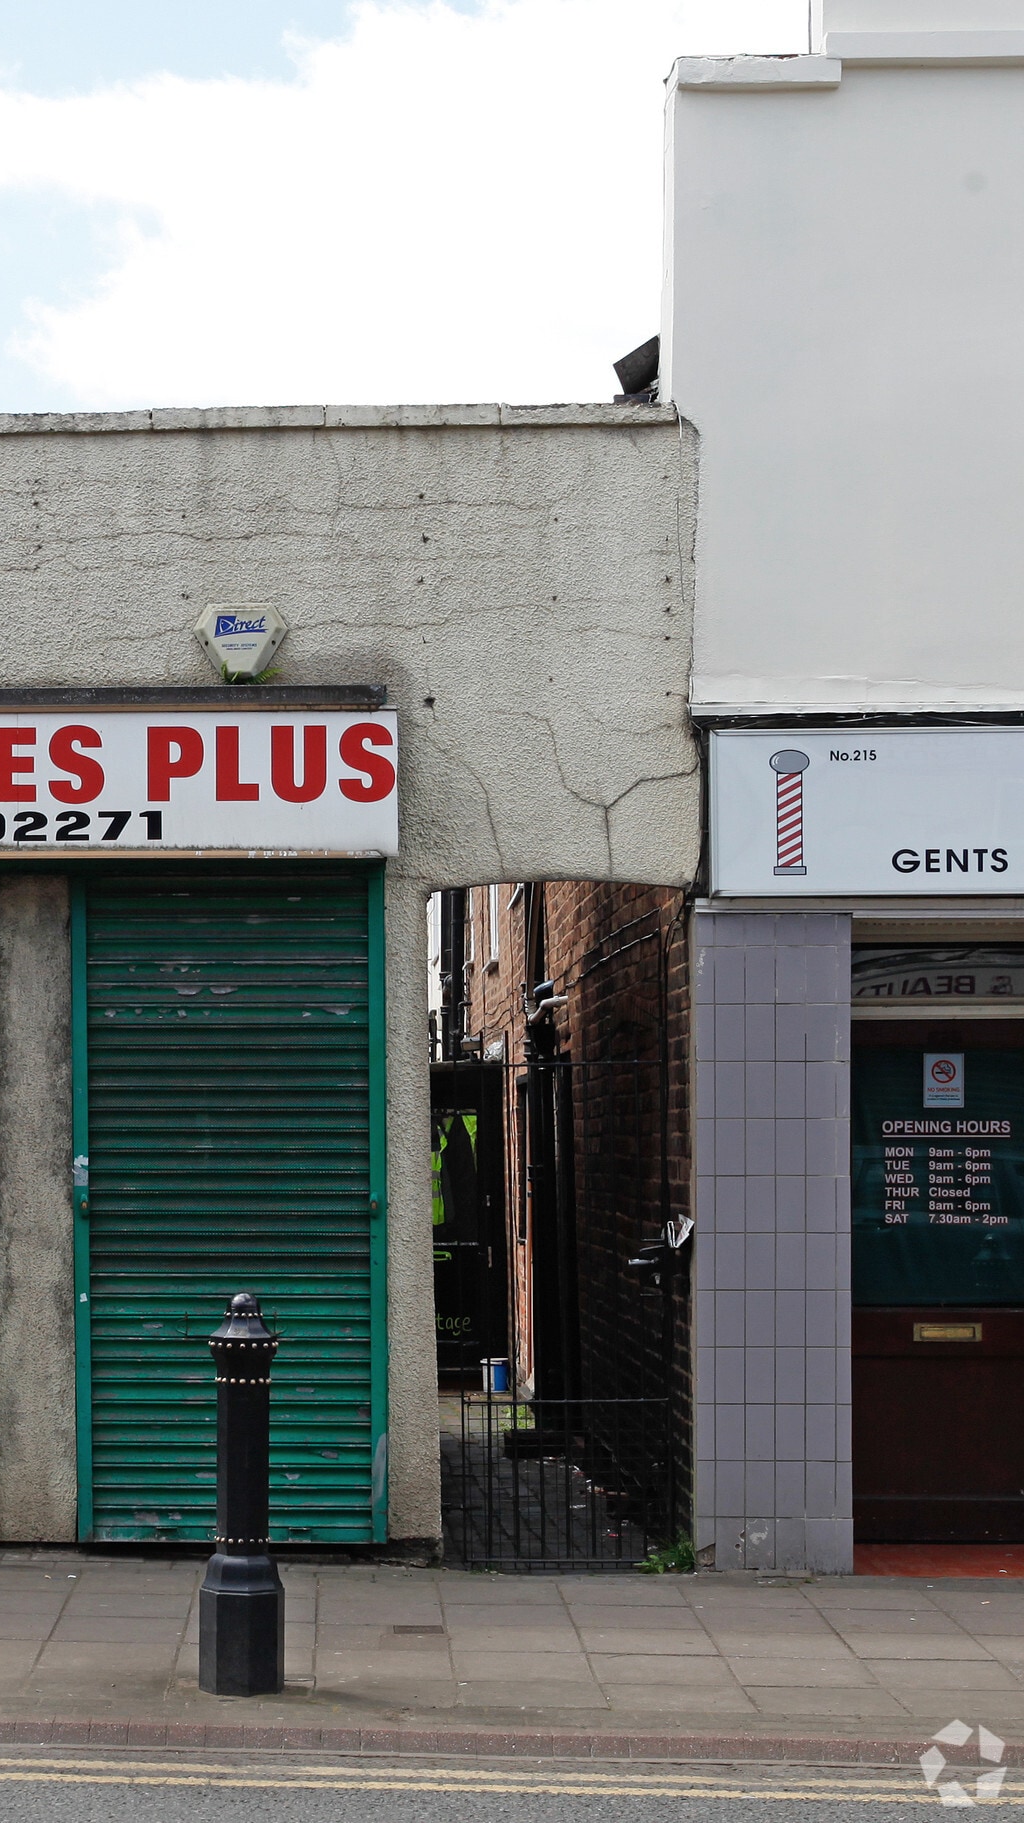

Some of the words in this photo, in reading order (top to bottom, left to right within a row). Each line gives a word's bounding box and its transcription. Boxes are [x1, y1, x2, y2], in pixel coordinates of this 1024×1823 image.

[214, 615, 268, 638] Direct
[830, 750, 876, 761] No.215
[146, 721, 395, 805] PLUS
[892, 849, 1008, 873] GENTS
[883, 1121, 951, 1132] OPENING
[957, 1121, 1010, 1133] HOURS
[886, 1148, 913, 1156] MON
[929, 1148, 953, 1156] 9am
[965, 1148, 990, 1158] 6pm
[885, 1161, 909, 1170] TUE
[929, 1161, 953, 1170] 9am
[965, 1161, 990, 1172] 6pm
[885, 1174, 913, 1183] WED
[929, 1174, 953, 1183] 9am
[965, 1174, 990, 1185] 6pm
[885, 1187, 919, 1196] THUR
[929, 1187, 970, 1196] Closed
[886, 1201, 904, 1209] FRI
[929, 1201, 953, 1210] 8am
[965, 1201, 990, 1212] 6pm
[885, 1214, 908, 1223] SAT
[929, 1214, 970, 1223] 7.30am
[983, 1214, 1007, 1225] 2pm
